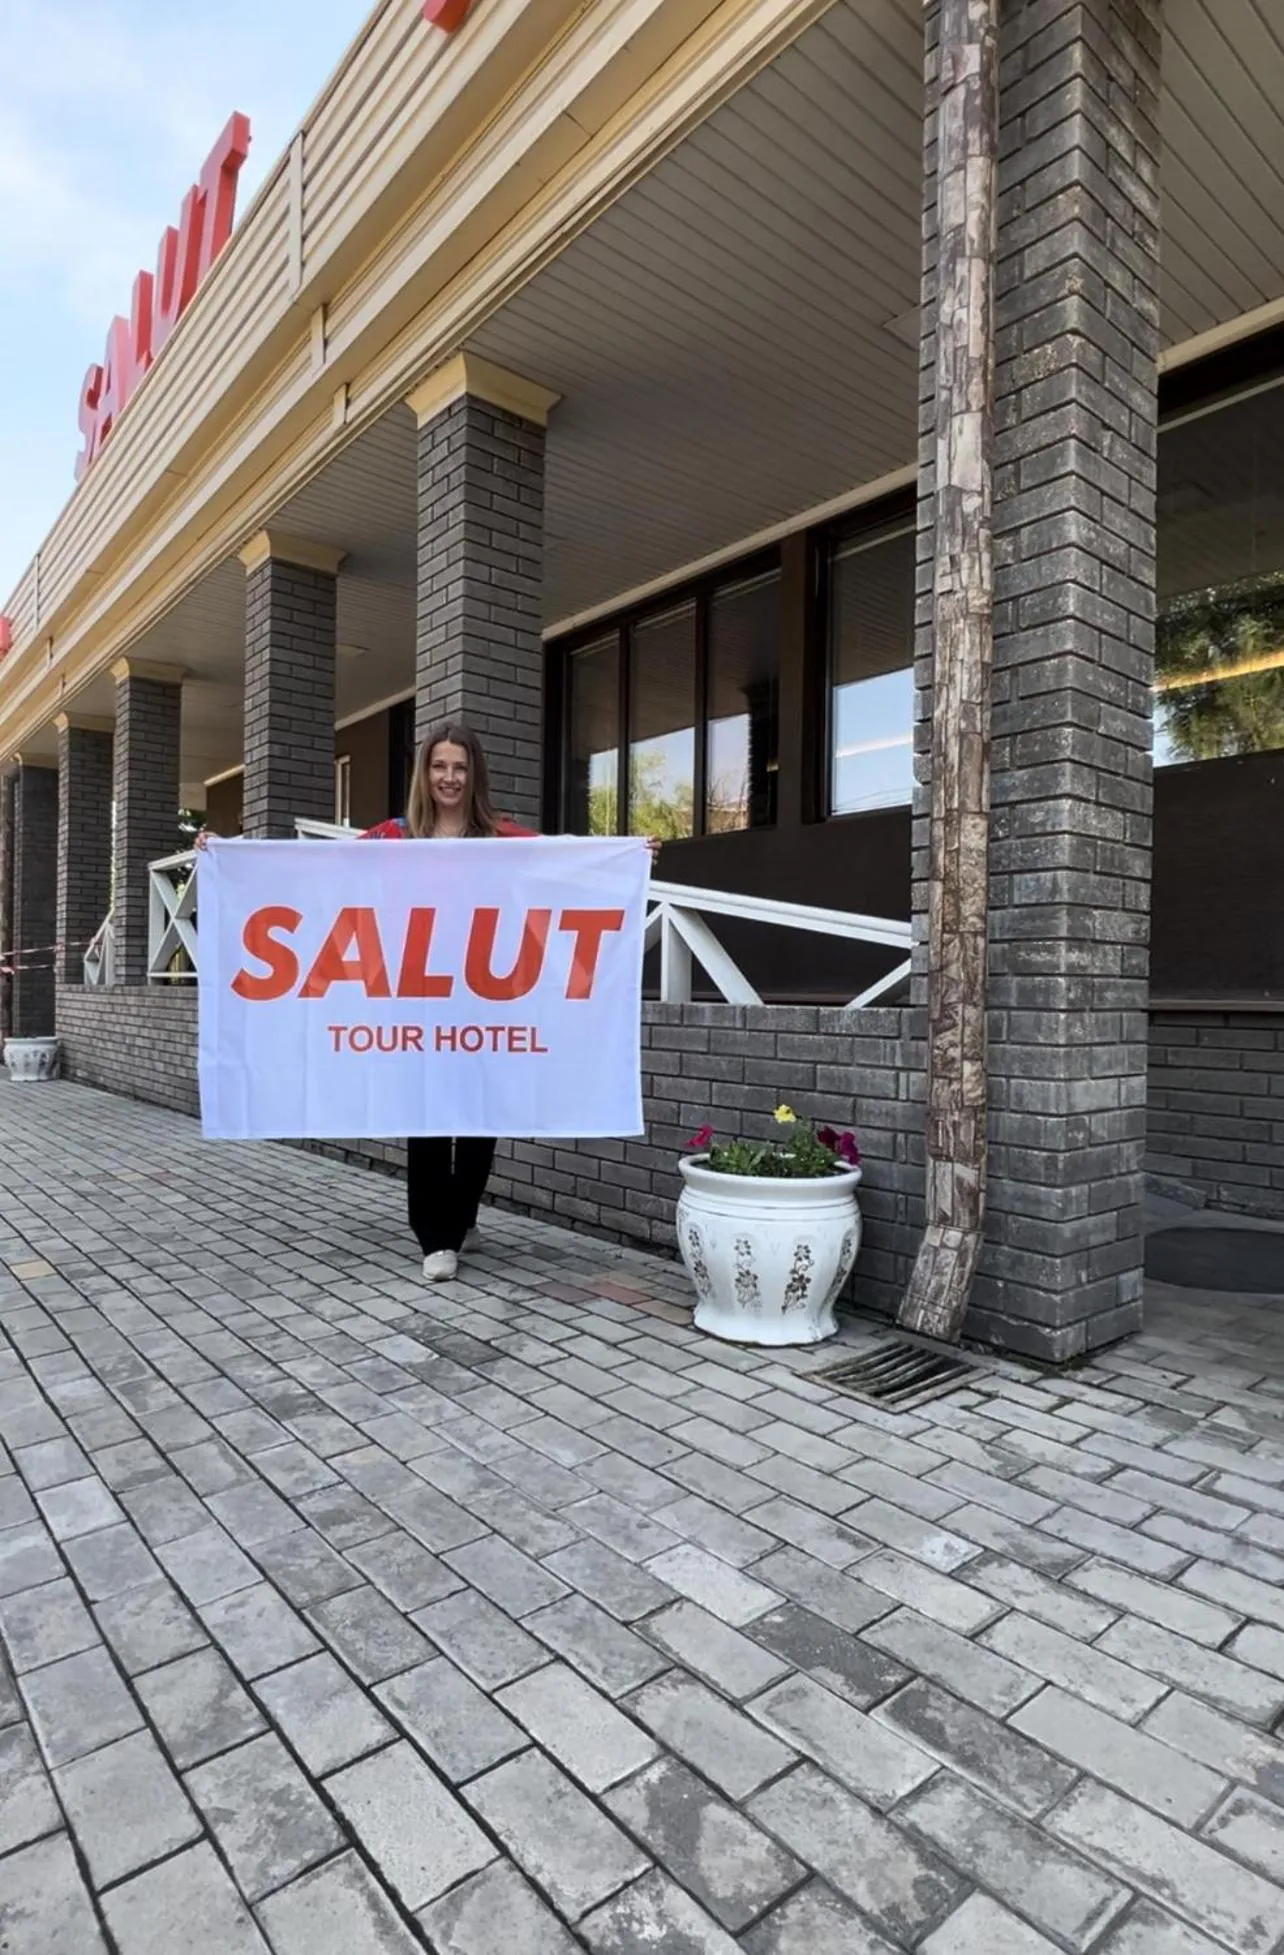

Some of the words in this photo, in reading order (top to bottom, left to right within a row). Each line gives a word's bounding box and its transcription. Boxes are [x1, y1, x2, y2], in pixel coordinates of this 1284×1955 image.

[230, 905, 626, 1001] SALUT
[327, 1025, 424, 1053] TOUR
[434, 1025, 549, 1054] HOTEL
